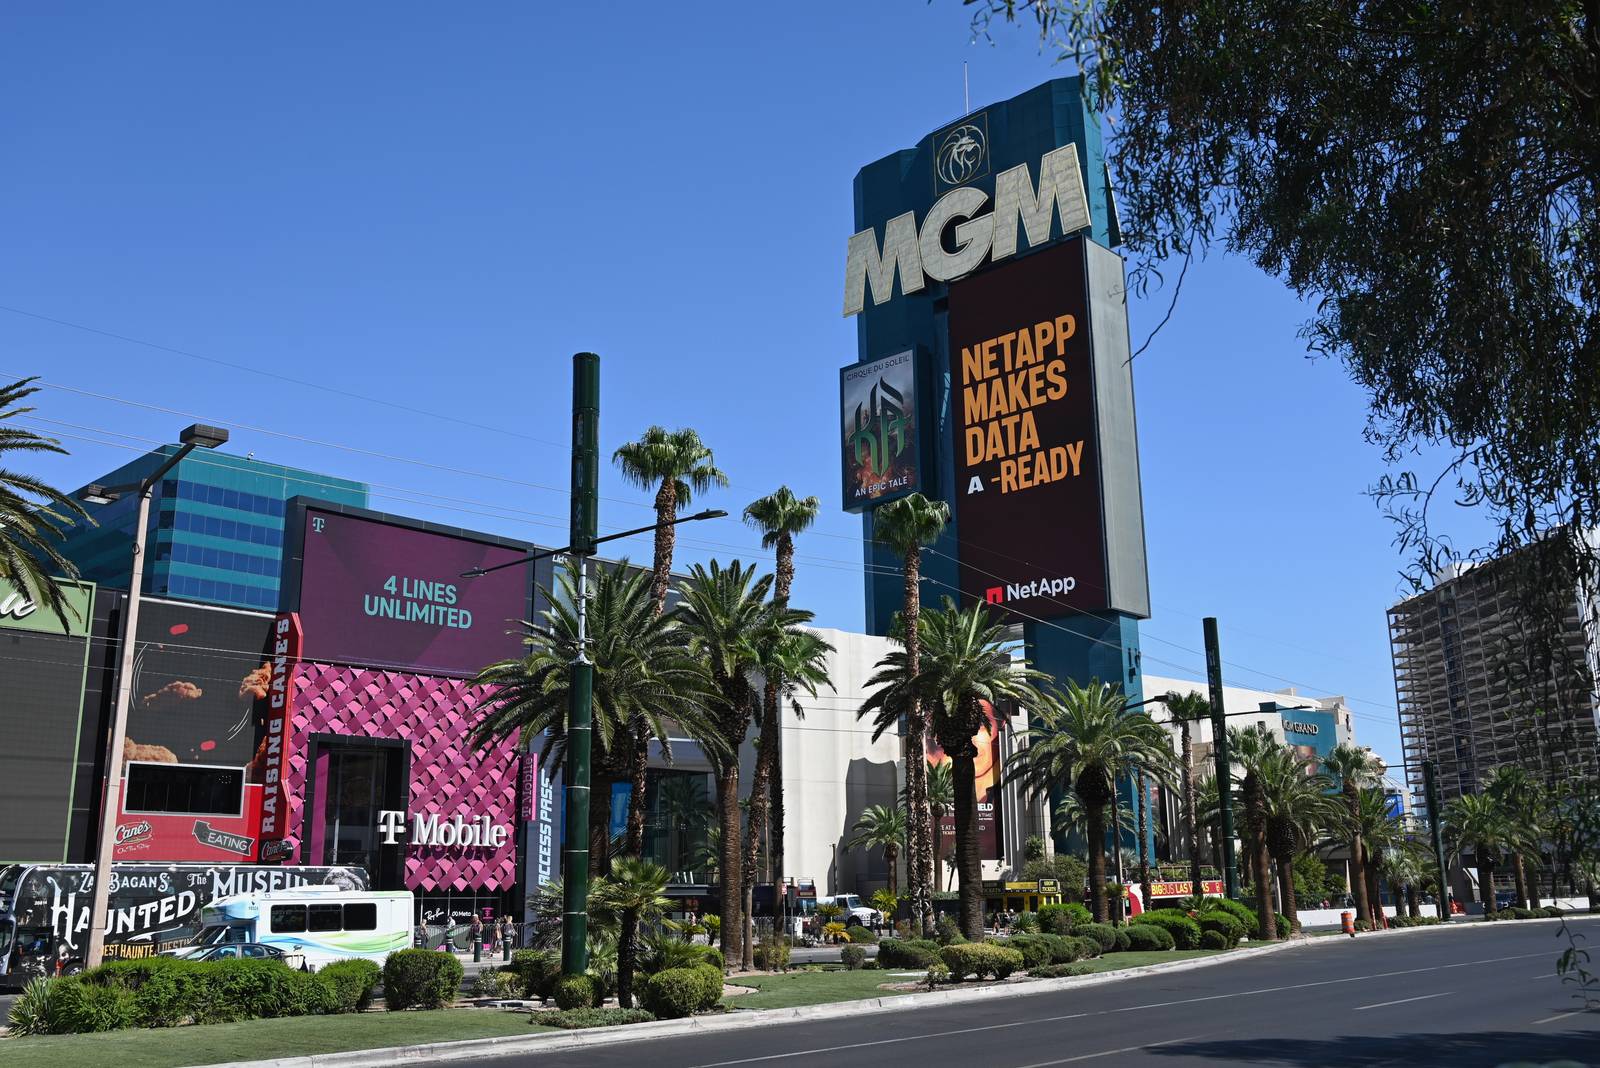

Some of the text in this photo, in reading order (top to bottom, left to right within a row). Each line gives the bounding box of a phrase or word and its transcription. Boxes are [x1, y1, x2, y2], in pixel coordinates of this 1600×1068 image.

[843, 142, 1091, 318] MGM
[962, 314, 1076, 385] NETAPP
[847, 354, 910, 381] CIRQUE DU SOLEIL
[963, 359, 1068, 426] MAKES
[965, 410, 1041, 467] DATA
[855, 475, 908, 497] AN EPIC TALE
[967, 475, 985, 495] A
[383, 575, 457, 605] 4 LINES
[1007, 576, 1076, 601] NetApp
[364, 594, 473, 629] UNLIMITED
[261, 617, 290, 834] RAISING CANE'S
[1294, 721, 1319, 736] GRAND
[113, 821, 151, 846] Cane's
[411, 812, 508, 848] Mobile
[539, 822, 552, 888] ACCESS
[1175, 881, 1188, 894] LAS
